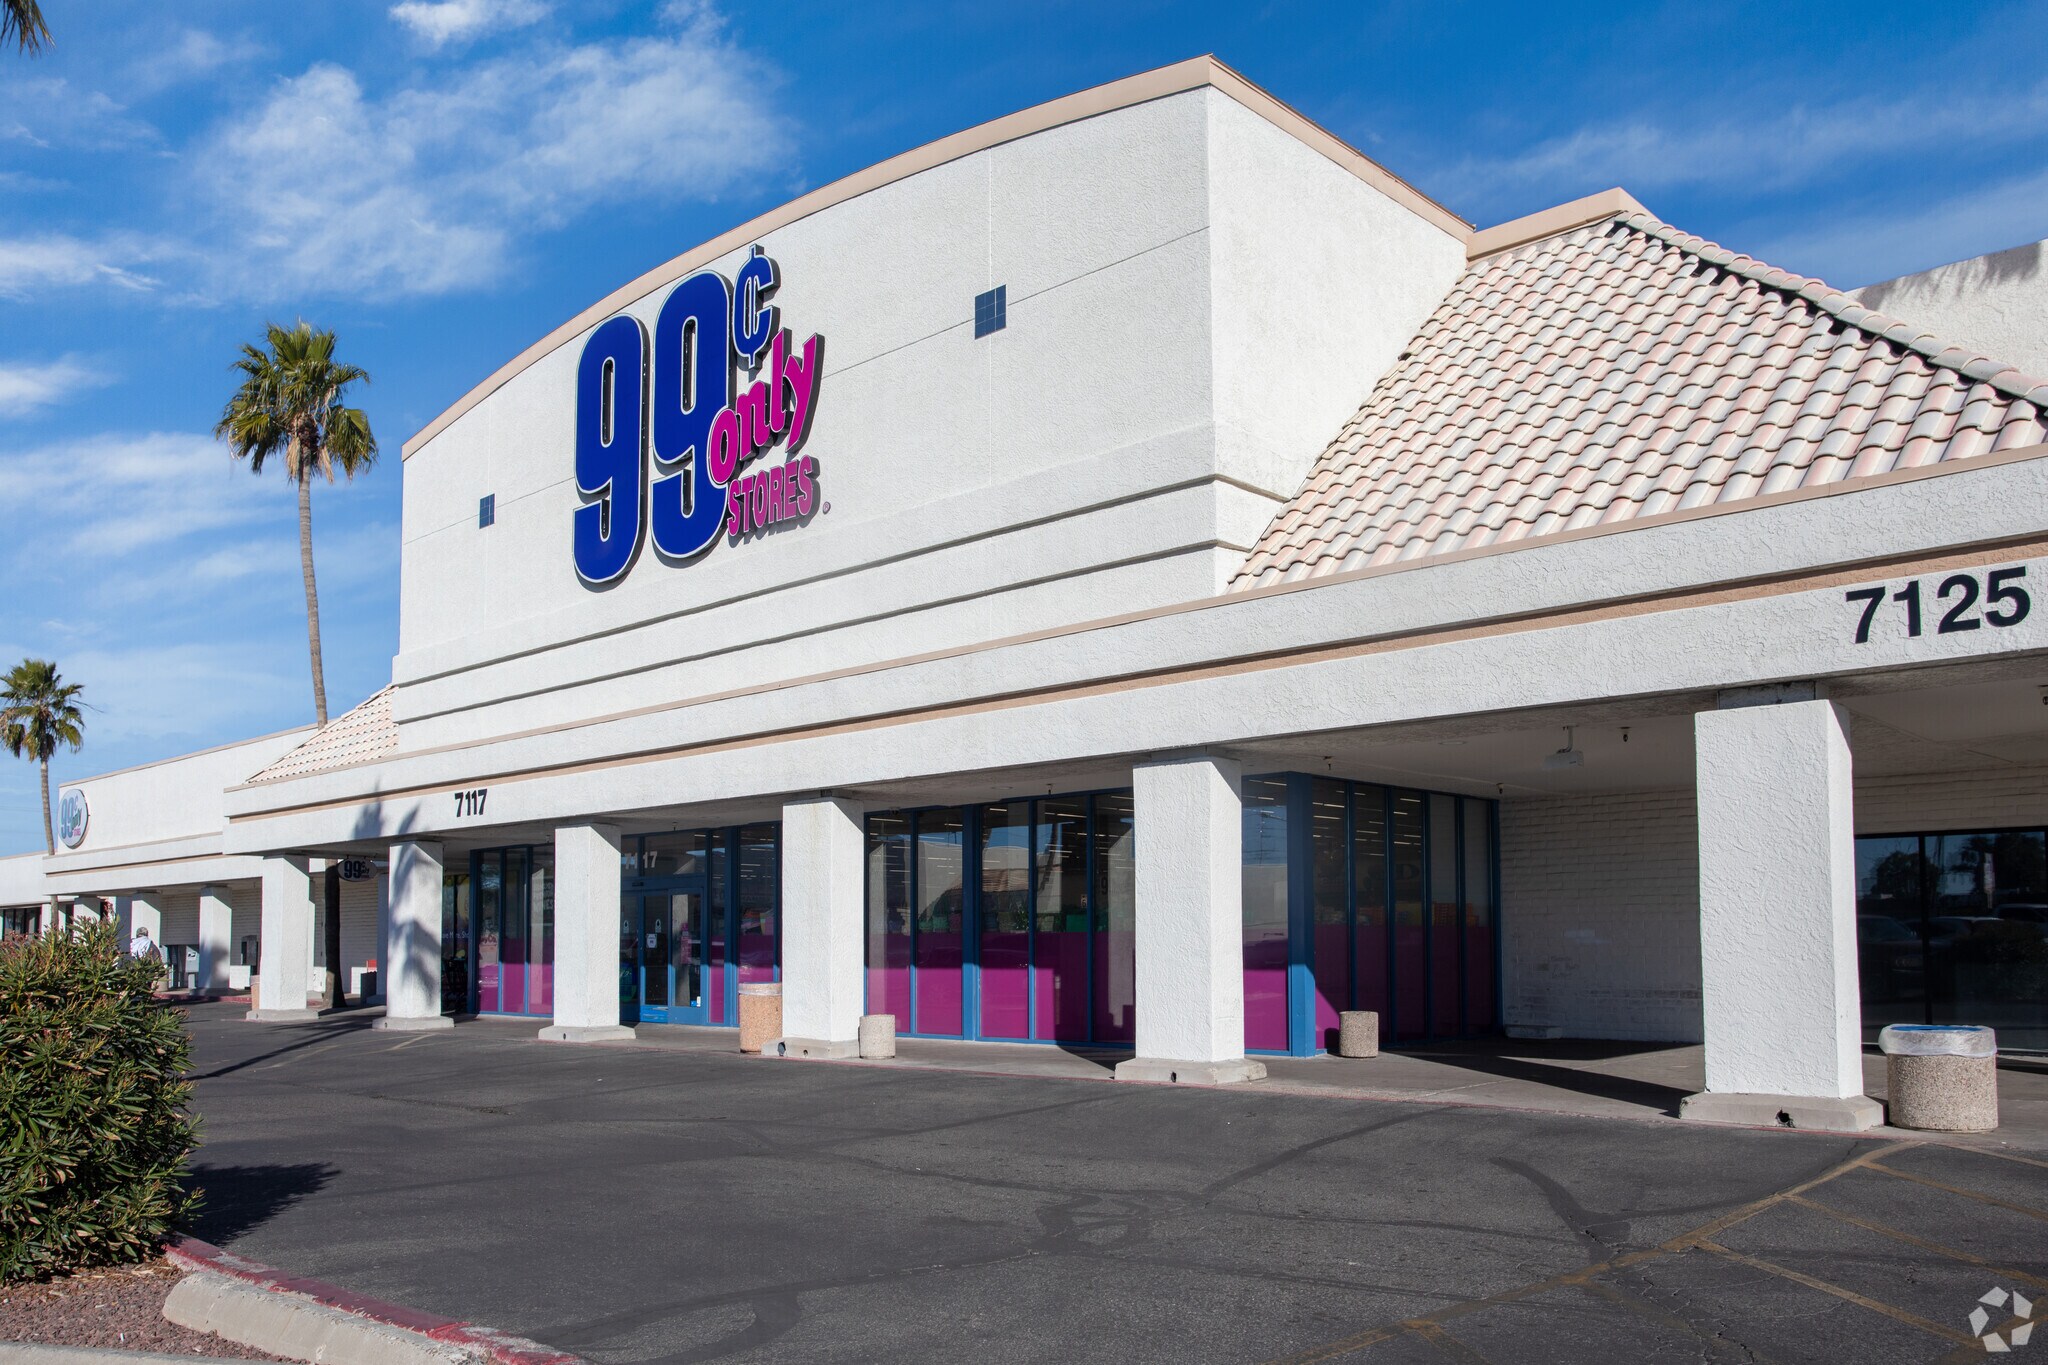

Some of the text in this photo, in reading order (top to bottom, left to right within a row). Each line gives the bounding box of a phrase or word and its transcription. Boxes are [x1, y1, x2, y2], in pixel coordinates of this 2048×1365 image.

[572, 243, 778, 584] 99¢
[708, 327, 819, 485] only
[727, 453, 814, 537] STORES
[1845, 565, 2031, 644] 7125
[454, 788, 488, 818] 7117
